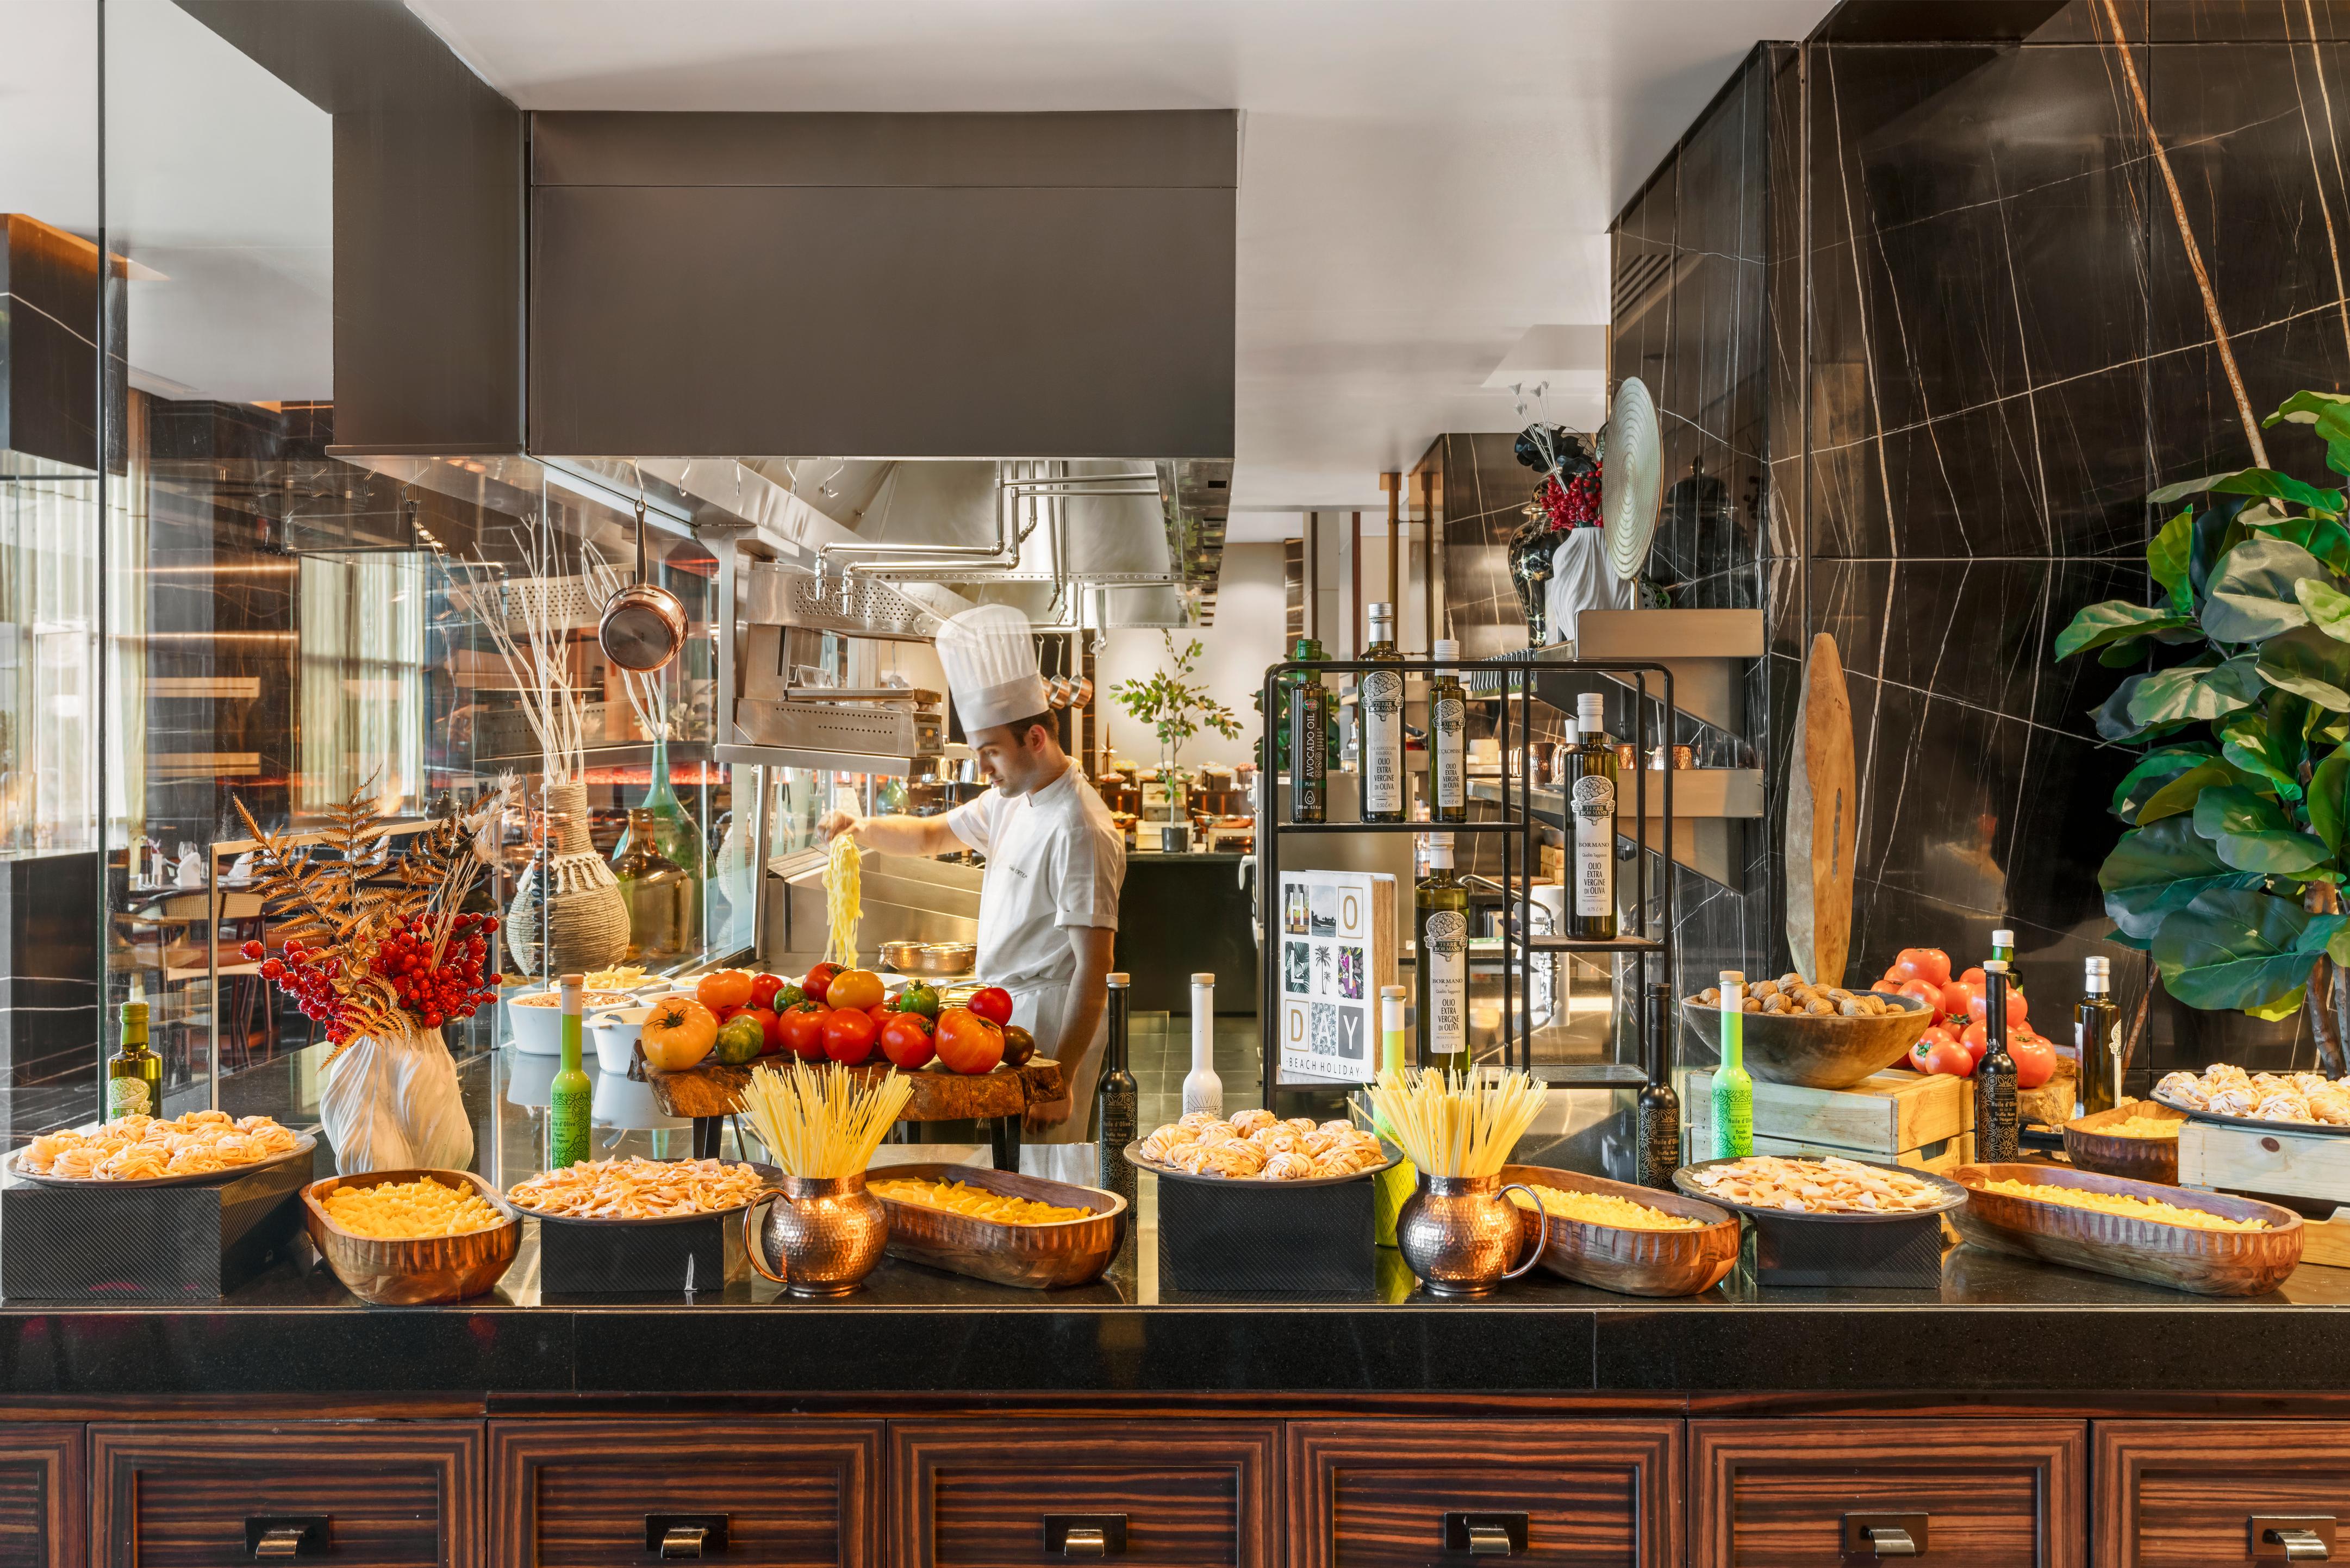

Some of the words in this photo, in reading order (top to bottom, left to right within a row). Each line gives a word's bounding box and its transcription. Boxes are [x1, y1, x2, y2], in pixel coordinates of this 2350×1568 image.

[1307, 713, 1315, 729] OIL
[1306, 731, 1315, 778] AVOCADO
[1289, 1057, 1316, 1070] BEACH
[1320, 1061, 1360, 1077] HOLIDAY
